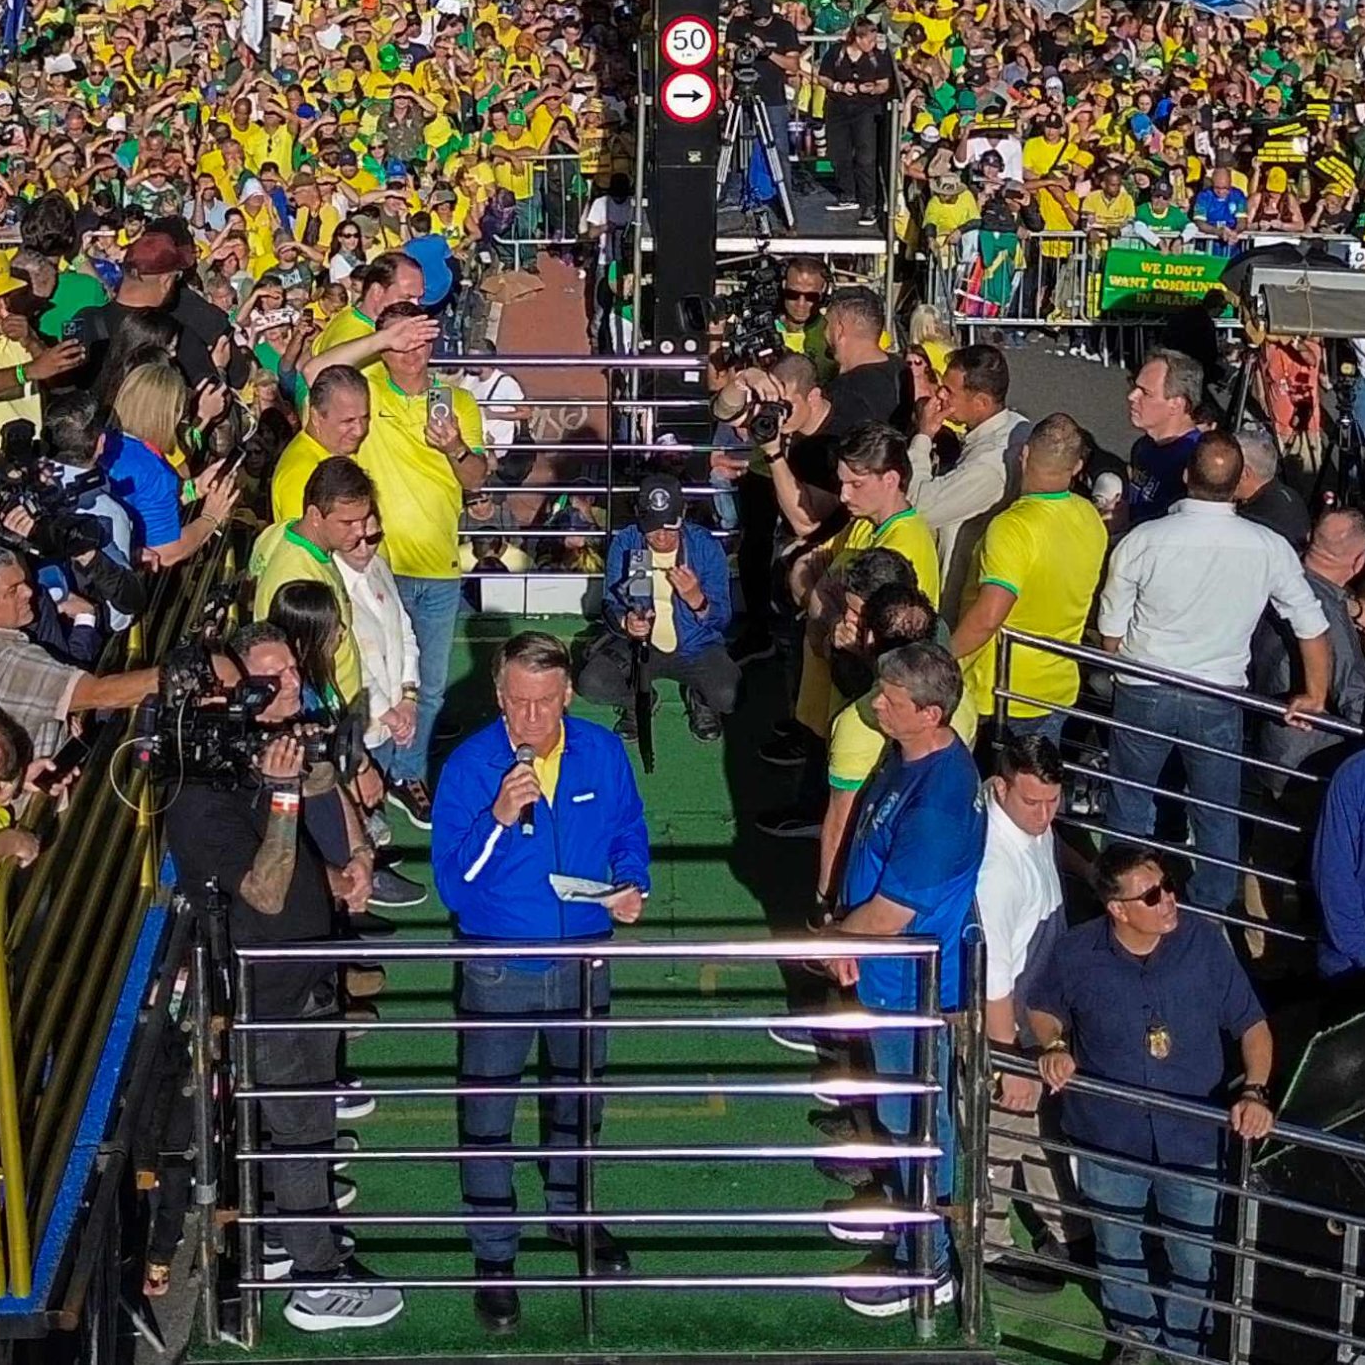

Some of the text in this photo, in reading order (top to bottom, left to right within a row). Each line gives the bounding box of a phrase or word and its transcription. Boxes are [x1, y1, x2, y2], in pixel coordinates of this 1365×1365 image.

[673, 29, 705, 50] 50
[1141, 261, 1161, 275] WE
[1109, 275, 1148, 289] WANT
